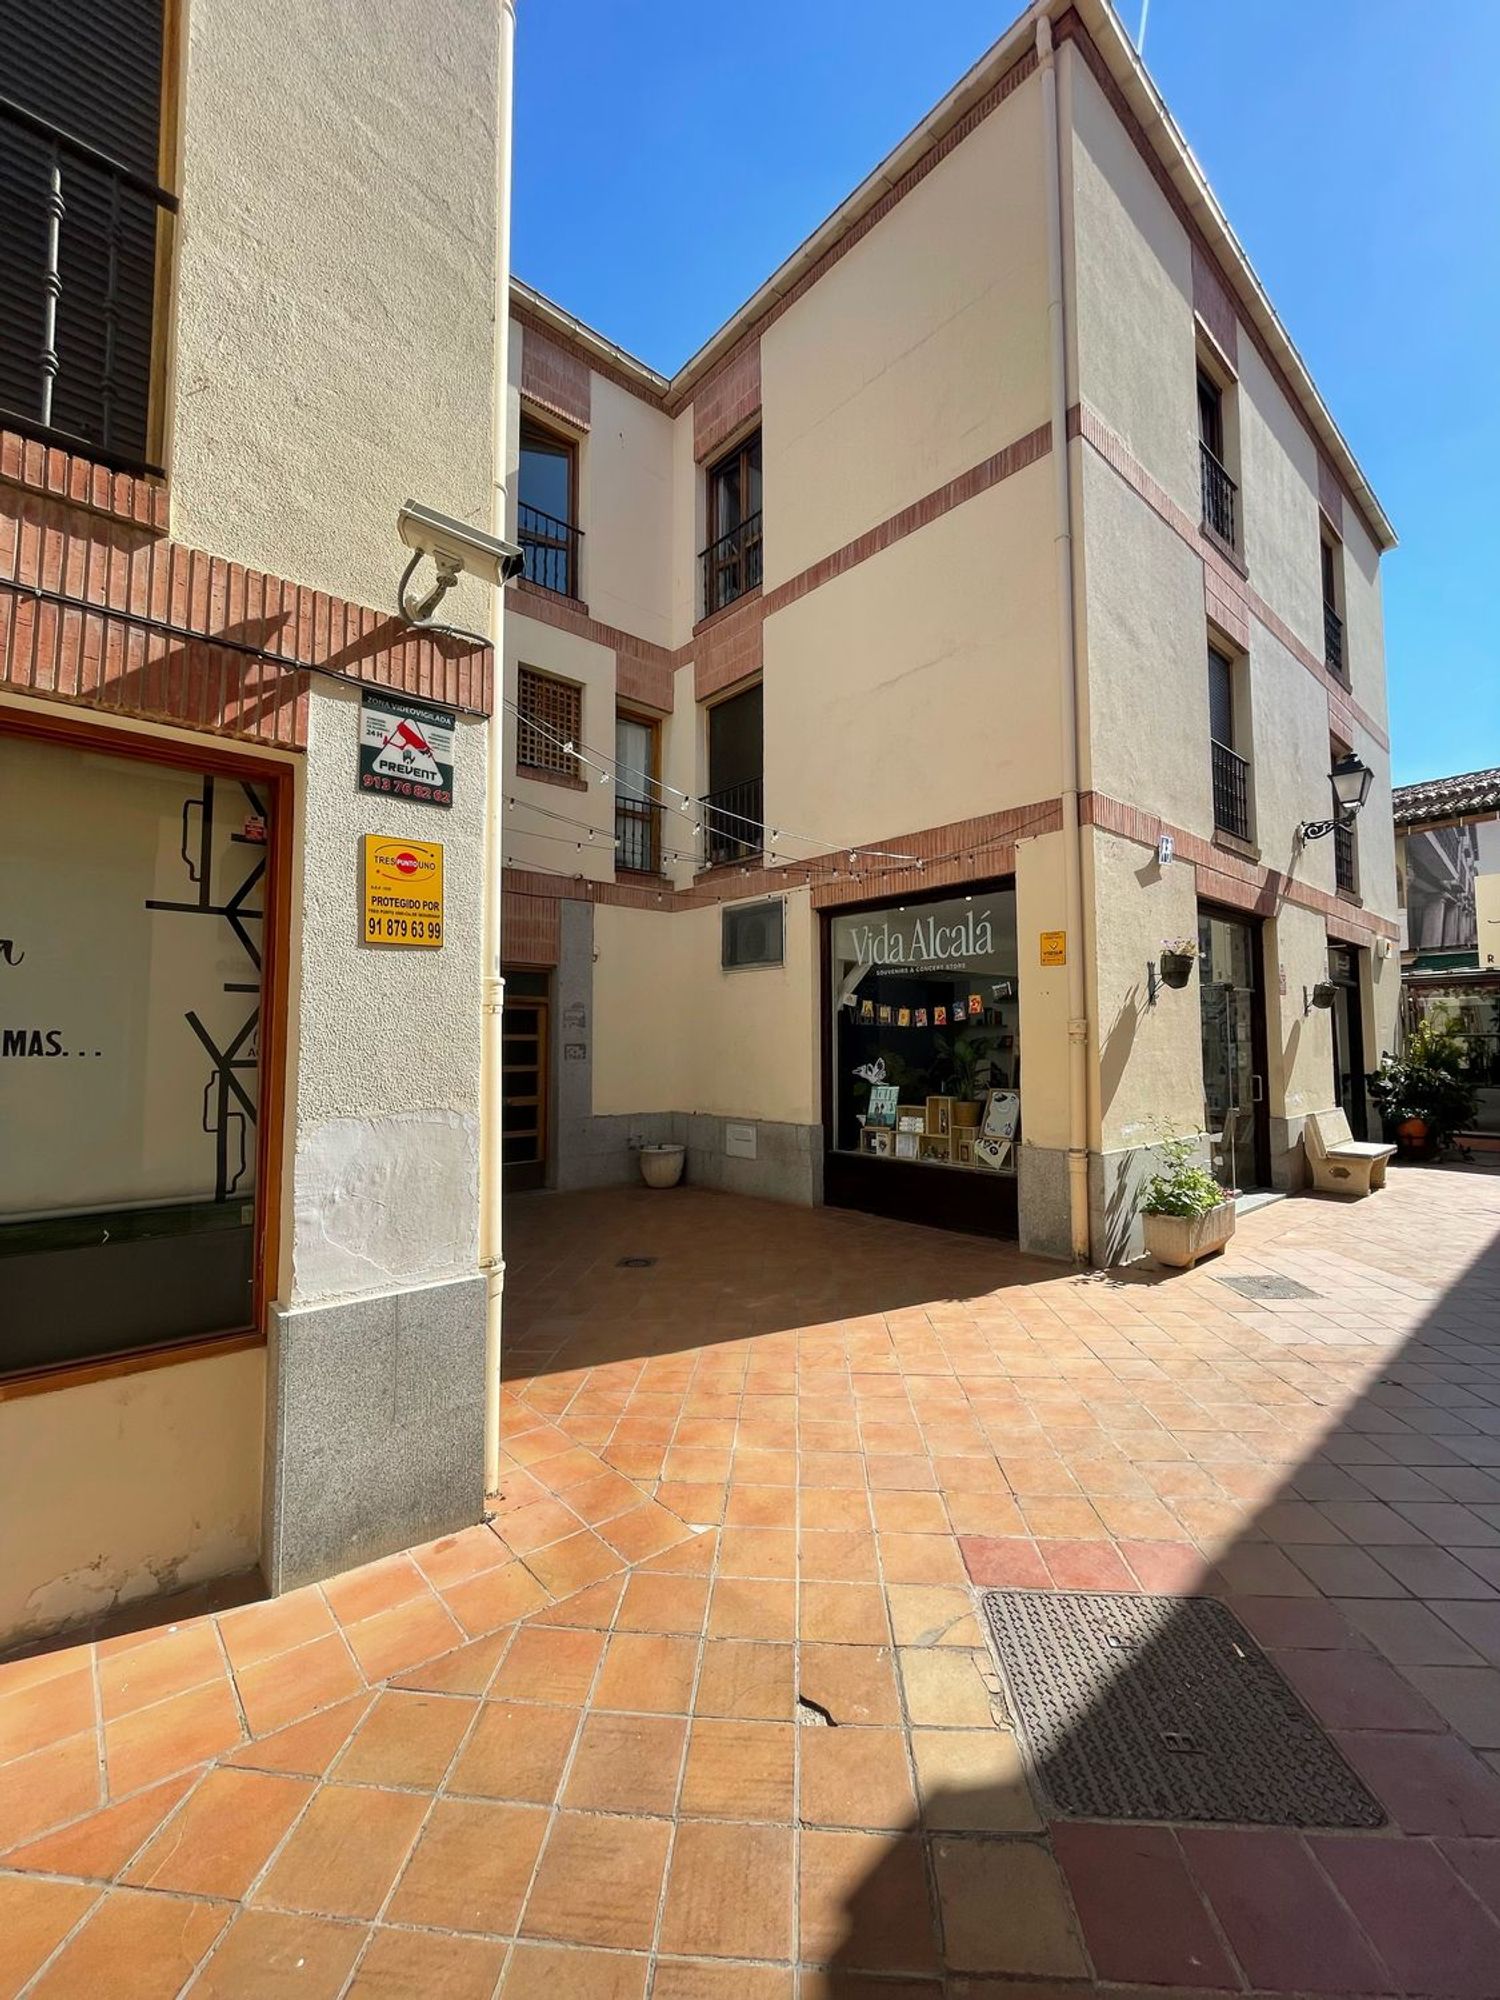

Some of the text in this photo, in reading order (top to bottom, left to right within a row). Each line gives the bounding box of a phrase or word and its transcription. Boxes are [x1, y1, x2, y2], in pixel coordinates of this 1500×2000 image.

[390, 703, 452, 725] VIDEOVIGILADA
[379, 759, 438, 781] PREVENT
[374, 855, 396, 866] TRES
[418, 862, 436, 871] UNO
[371, 896, 440, 912] PROTEGIDO POR
[369, 917, 441, 939] 91 879 63 99
[850, 923, 905, 966] Vida
[908, 910, 995, 962] Alcalá
